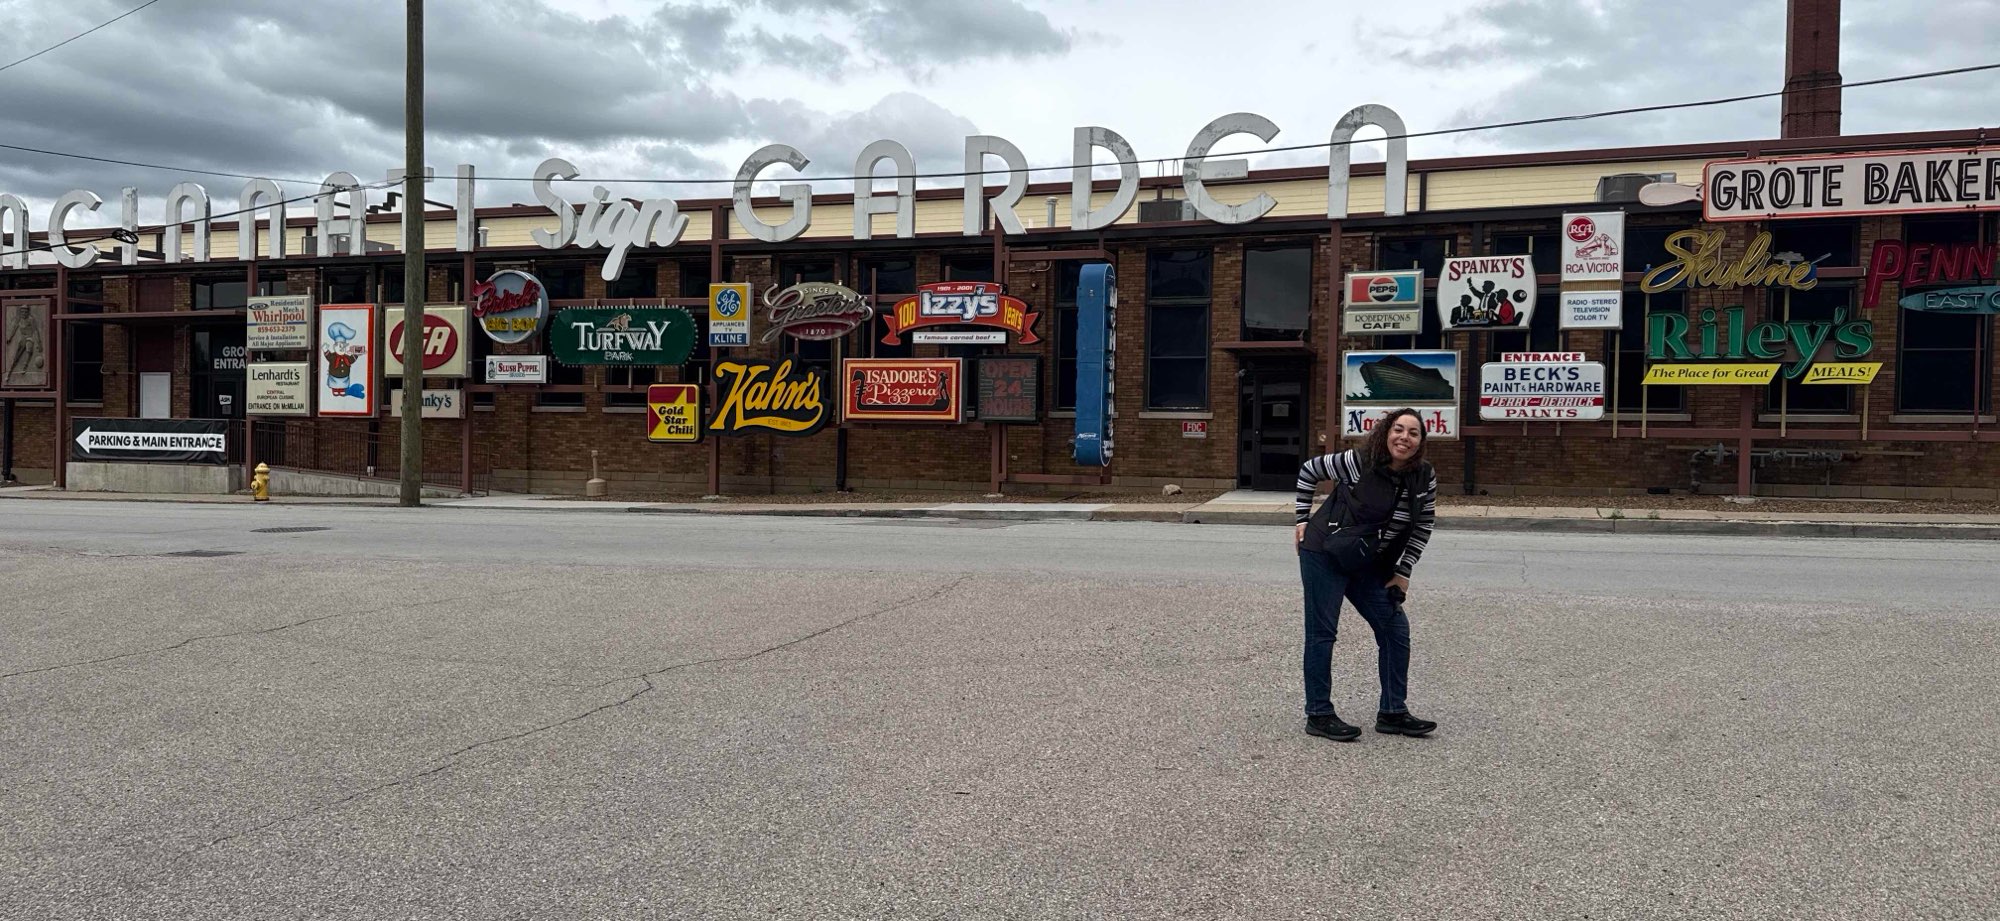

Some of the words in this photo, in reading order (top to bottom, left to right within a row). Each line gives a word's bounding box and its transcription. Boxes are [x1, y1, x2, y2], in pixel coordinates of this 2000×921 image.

[530, 157, 690, 282] Sign
[732, 103, 1407, 243] GARDEN
[1711, 164, 1844, 211] GROTE
[1569, 223, 1594, 236] RCA
[1565, 263, 1585, 274] RCA
[1586, 262, 1619, 273] VICTOR
[1640, 229, 1818, 294] Skyline
[1448, 257, 1525, 281] SPANKY'S
[1862, 238, 1999, 309] PENN
[1369, 285, 1399, 294] PEPSI
[920, 285, 998, 321] Izzy's
[1923, 292, 1983, 309] EAST
[252, 309, 305, 325] Whirlpool
[898, 301, 916, 329] 100
[1003, 299, 1023, 330] Years
[257, 325, 296, 333] 859-653-2379
[486, 316, 509, 332] BIG
[511, 316, 539, 332] BOY
[1362, 322, 1401, 330] CAFE
[570, 320, 671, 351] TURFWAY
[713, 334, 743, 344] KLINE
[1646, 306, 1873, 379] Riley's
[222, 345, 247, 357] GRO
[603, 351, 634, 362] PARK
[1503, 353, 1581, 362] ENTRANCE
[213, 358, 247, 369] ENTRA
[498, 362, 516, 373] SLUSH
[517, 362, 539, 373] PUPPIE
[985, 361, 1032, 378] OPEN
[252, 368, 300, 381] Lenhardt's
[866, 367, 937, 383] ISADORE'S
[1504, 366, 1580, 381] BECK'S
[1652, 367, 1674, 378] The
[1677, 367, 1710, 378] Place
[1711, 367, 1731, 380] for
[1734, 367, 1770, 378] Great
[1811, 366, 1872, 377] MEALS!
[865, 383, 939, 405] Pizzeria
[994, 379, 1022, 397] 24
[1484, 382, 1522, 393] PAINT
[1528, 382, 1602, 393] HARDWARE
[709, 359, 824, 431] Kahn's
[1489, 396, 1532, 407] PERRY
[1540, 396, 1596, 407] DERRICK
[248, 402, 272, 410] ENTRANCE
[273, 402, 281, 410] ON
[281, 402, 305, 410] McMILLAN
[658, 405, 684, 416] Gold
[983, 399, 1032, 416] HOURS
[664, 415, 688, 425] Star
[1505, 409, 1578, 418] PAINTS
[667, 425, 694, 435] Chili
[1186, 422, 1202, 432] FDC
[88, 434, 131, 446] PARKING
[132, 435, 141, 447] &
[141, 436, 168, 447] MAIN
[169, 436, 222, 449] ENTRANCE
